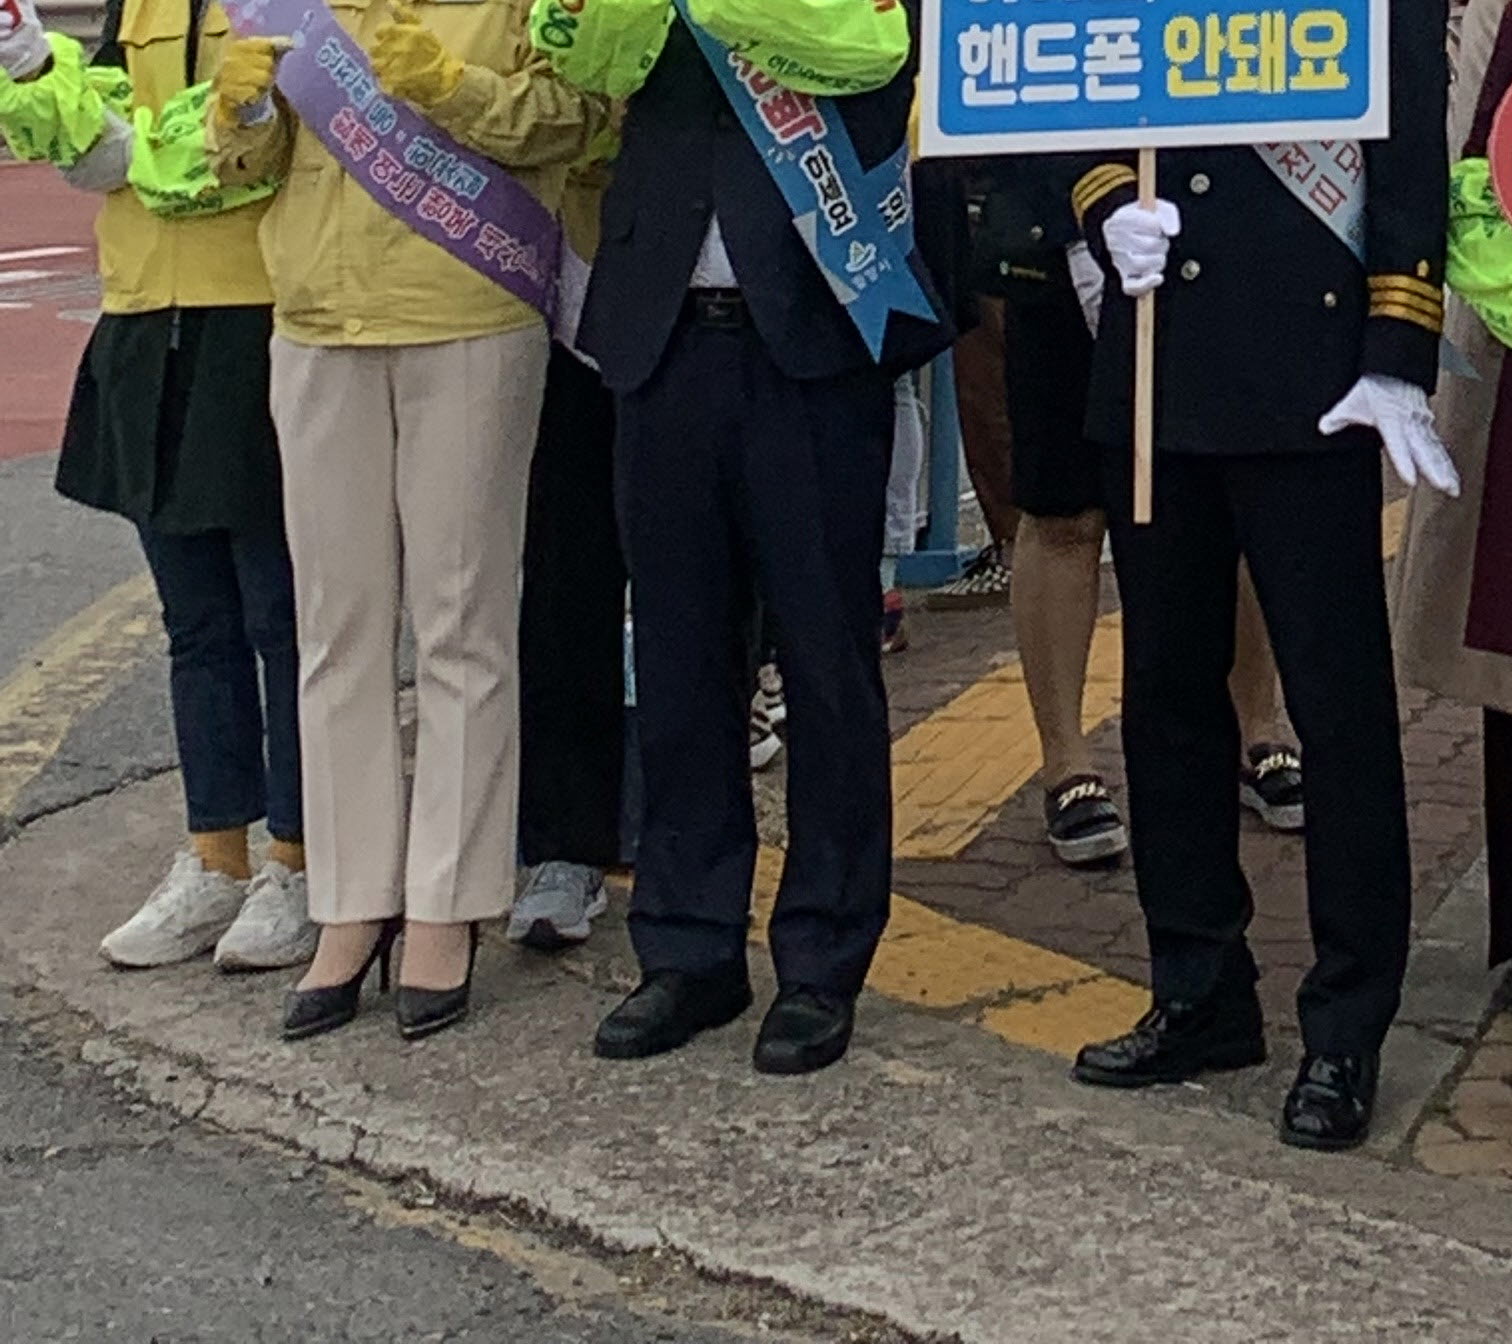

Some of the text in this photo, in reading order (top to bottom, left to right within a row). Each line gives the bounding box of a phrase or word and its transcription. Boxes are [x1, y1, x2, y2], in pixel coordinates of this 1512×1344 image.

[957, 16, 1143, 107] 핸드폰
[1163, 8, 1350, 98] 안돼요
[416, 183, 480, 241] 행복
[800, 146, 859, 237] 하세요
